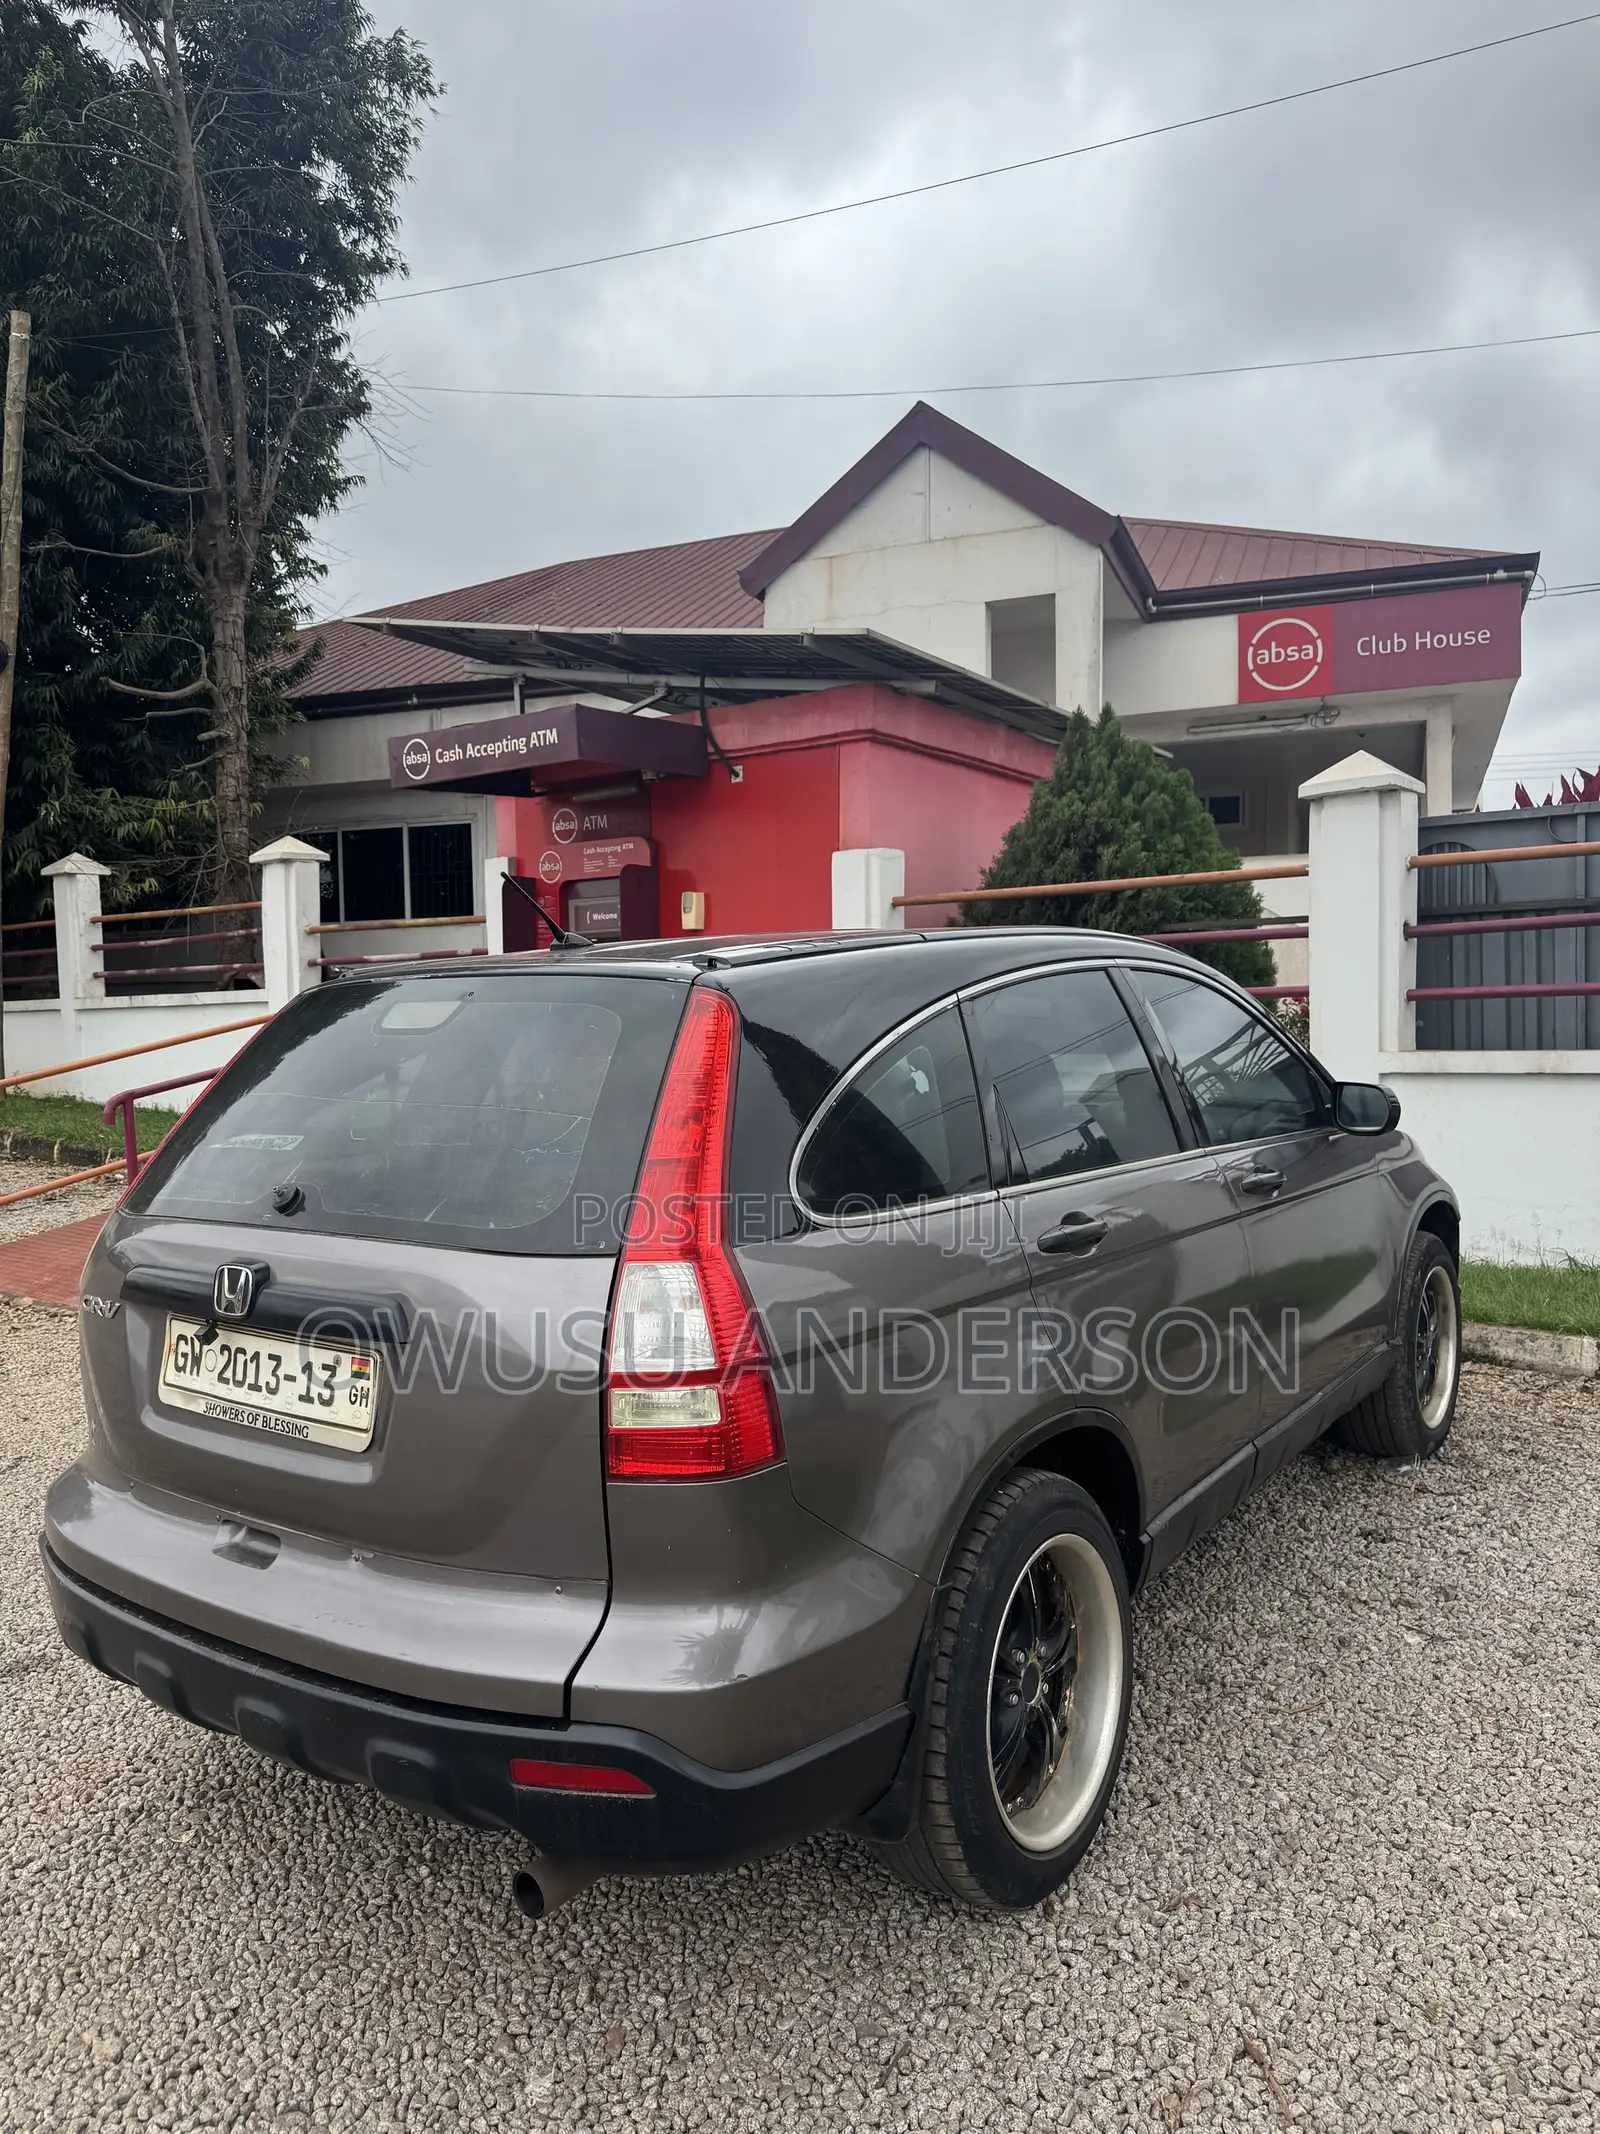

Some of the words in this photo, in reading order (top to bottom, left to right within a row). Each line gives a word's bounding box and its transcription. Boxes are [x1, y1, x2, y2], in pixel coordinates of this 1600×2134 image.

[1356, 633, 1407, 656] Club
[1415, 628, 1491, 650] House
[1256, 641, 1315, 665] absa
[435, 744, 463, 764] Cash
[466, 735, 527, 758] Accepting
[530, 728, 559, 748] ATM
[406, 751, 428, 765] absa
[555, 819, 575, 831] absa
[583, 814, 608, 831] ATM
[583, 847, 596, 855] Cash
[596, 844, 622, 854] Accepting
[541, 860, 560, 871] absa
[592, 912, 618, 920] Welcome
[174, 1333, 204, 1378] GW
[216, 1343, 338, 1408] 2013-13
[348, 1385, 370, 1408] GH
[203, 1401, 245, 1423] SHOWERS
[246, 1412, 261, 1426] OF
[261, 1415, 310, 1439] BLESSING
